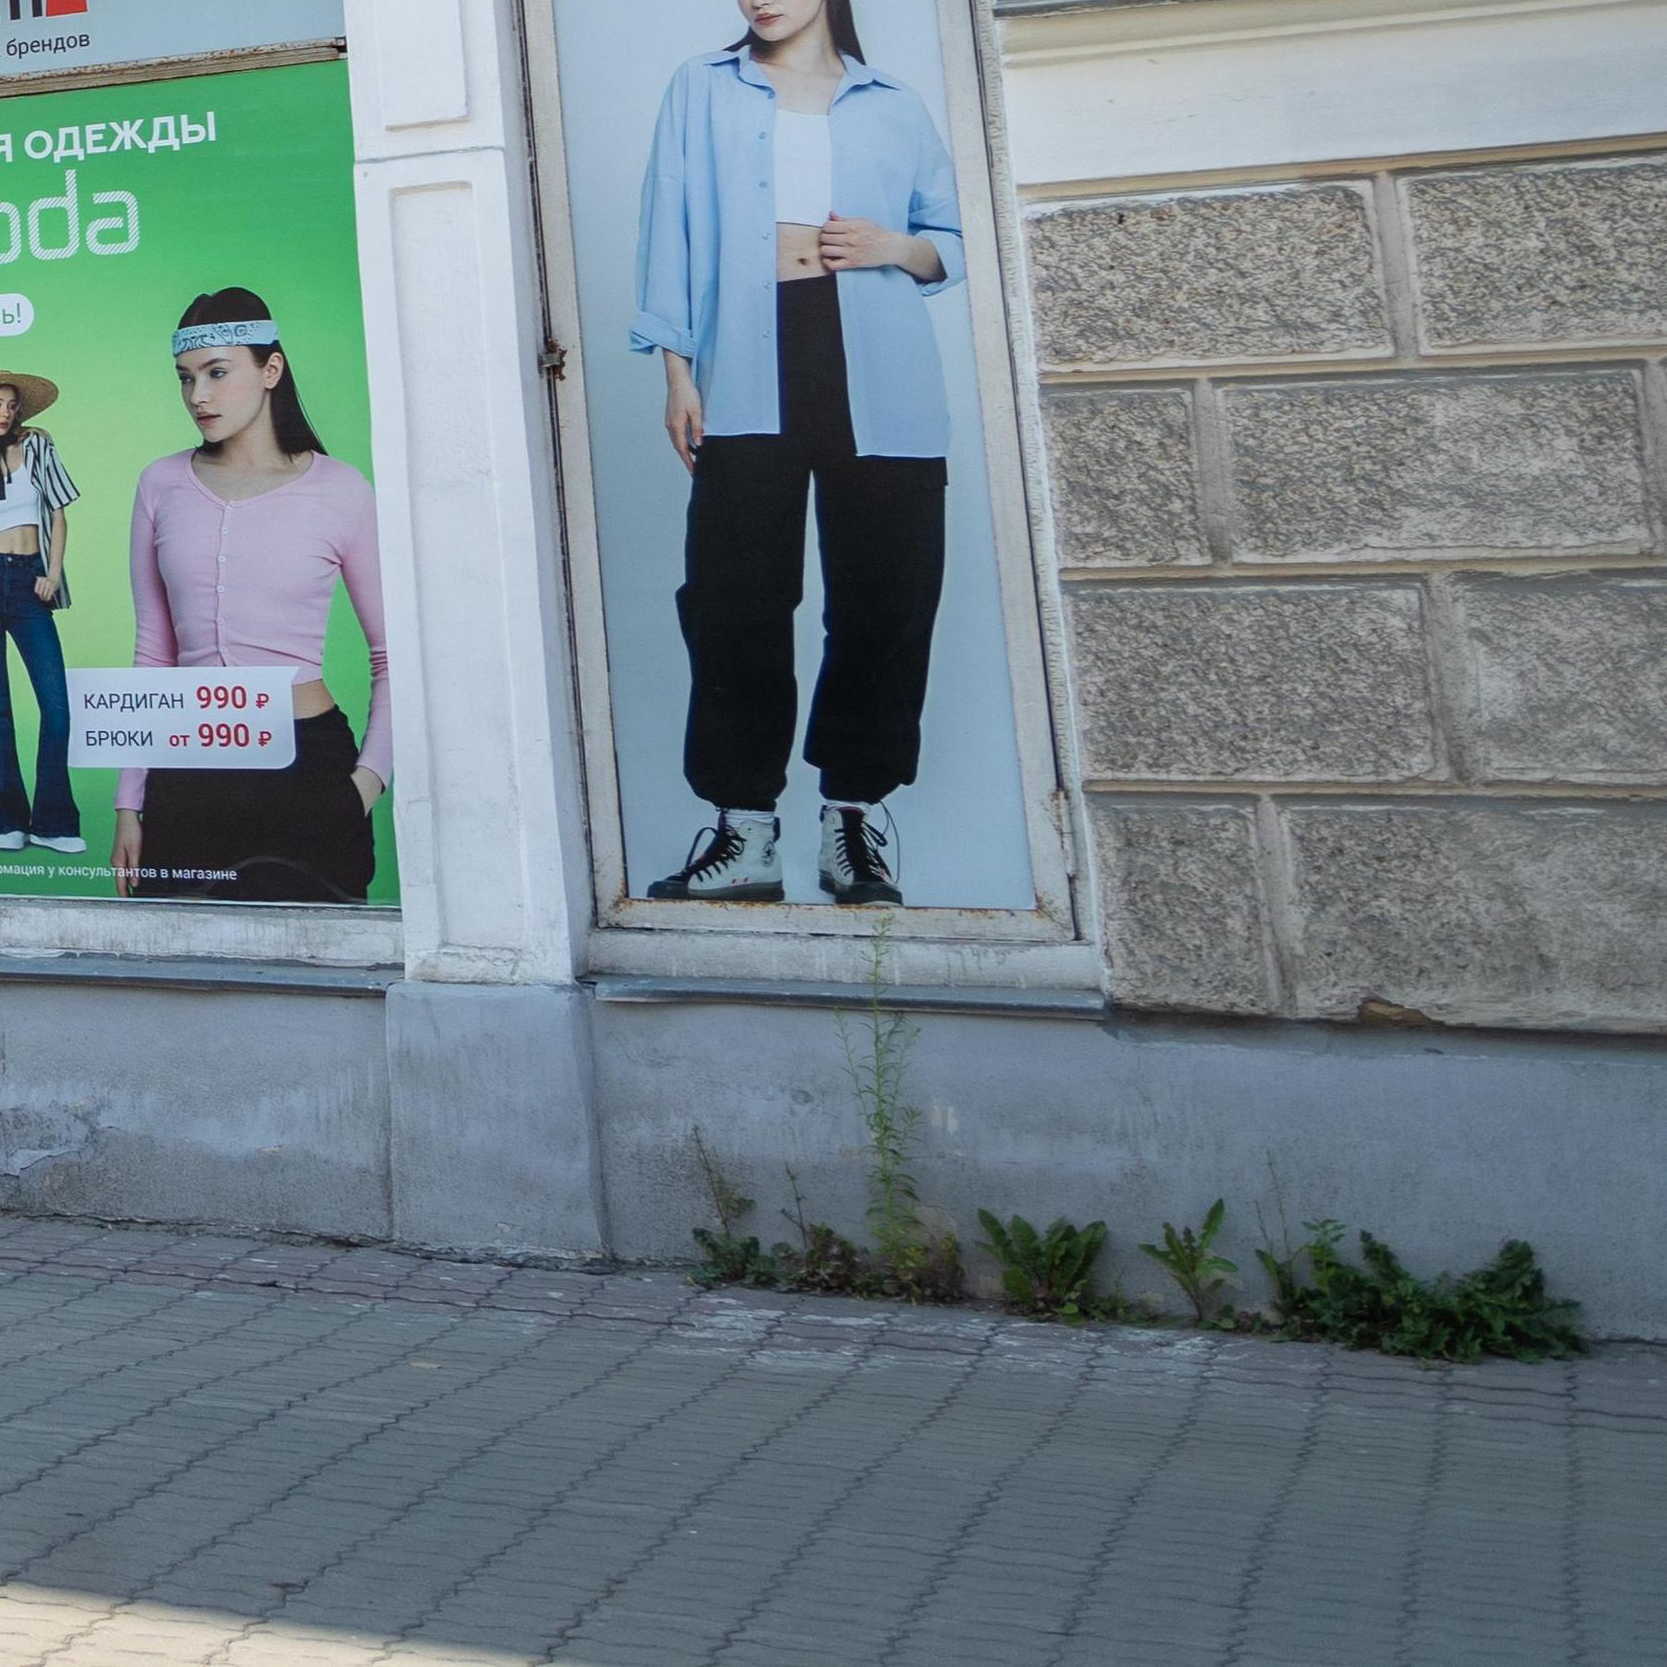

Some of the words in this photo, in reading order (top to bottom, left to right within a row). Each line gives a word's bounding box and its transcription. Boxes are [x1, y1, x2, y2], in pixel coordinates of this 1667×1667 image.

[7, 34, 90, 59] брендов
[24, 111, 217, 161] ОДЕЖДЫ
[84, 693, 184, 712] КАРДИГАН
[196, 686, 247, 709] 990
[86, 730, 153, 746] БРЮКИ
[169, 734, 190, 747] от
[198, 723, 249, 747] 990
[48, 867, 55, 878] у
[58, 866, 156, 879] консультантов
[160, 868, 168, 878] в
[172, 868, 237, 881] магазине
